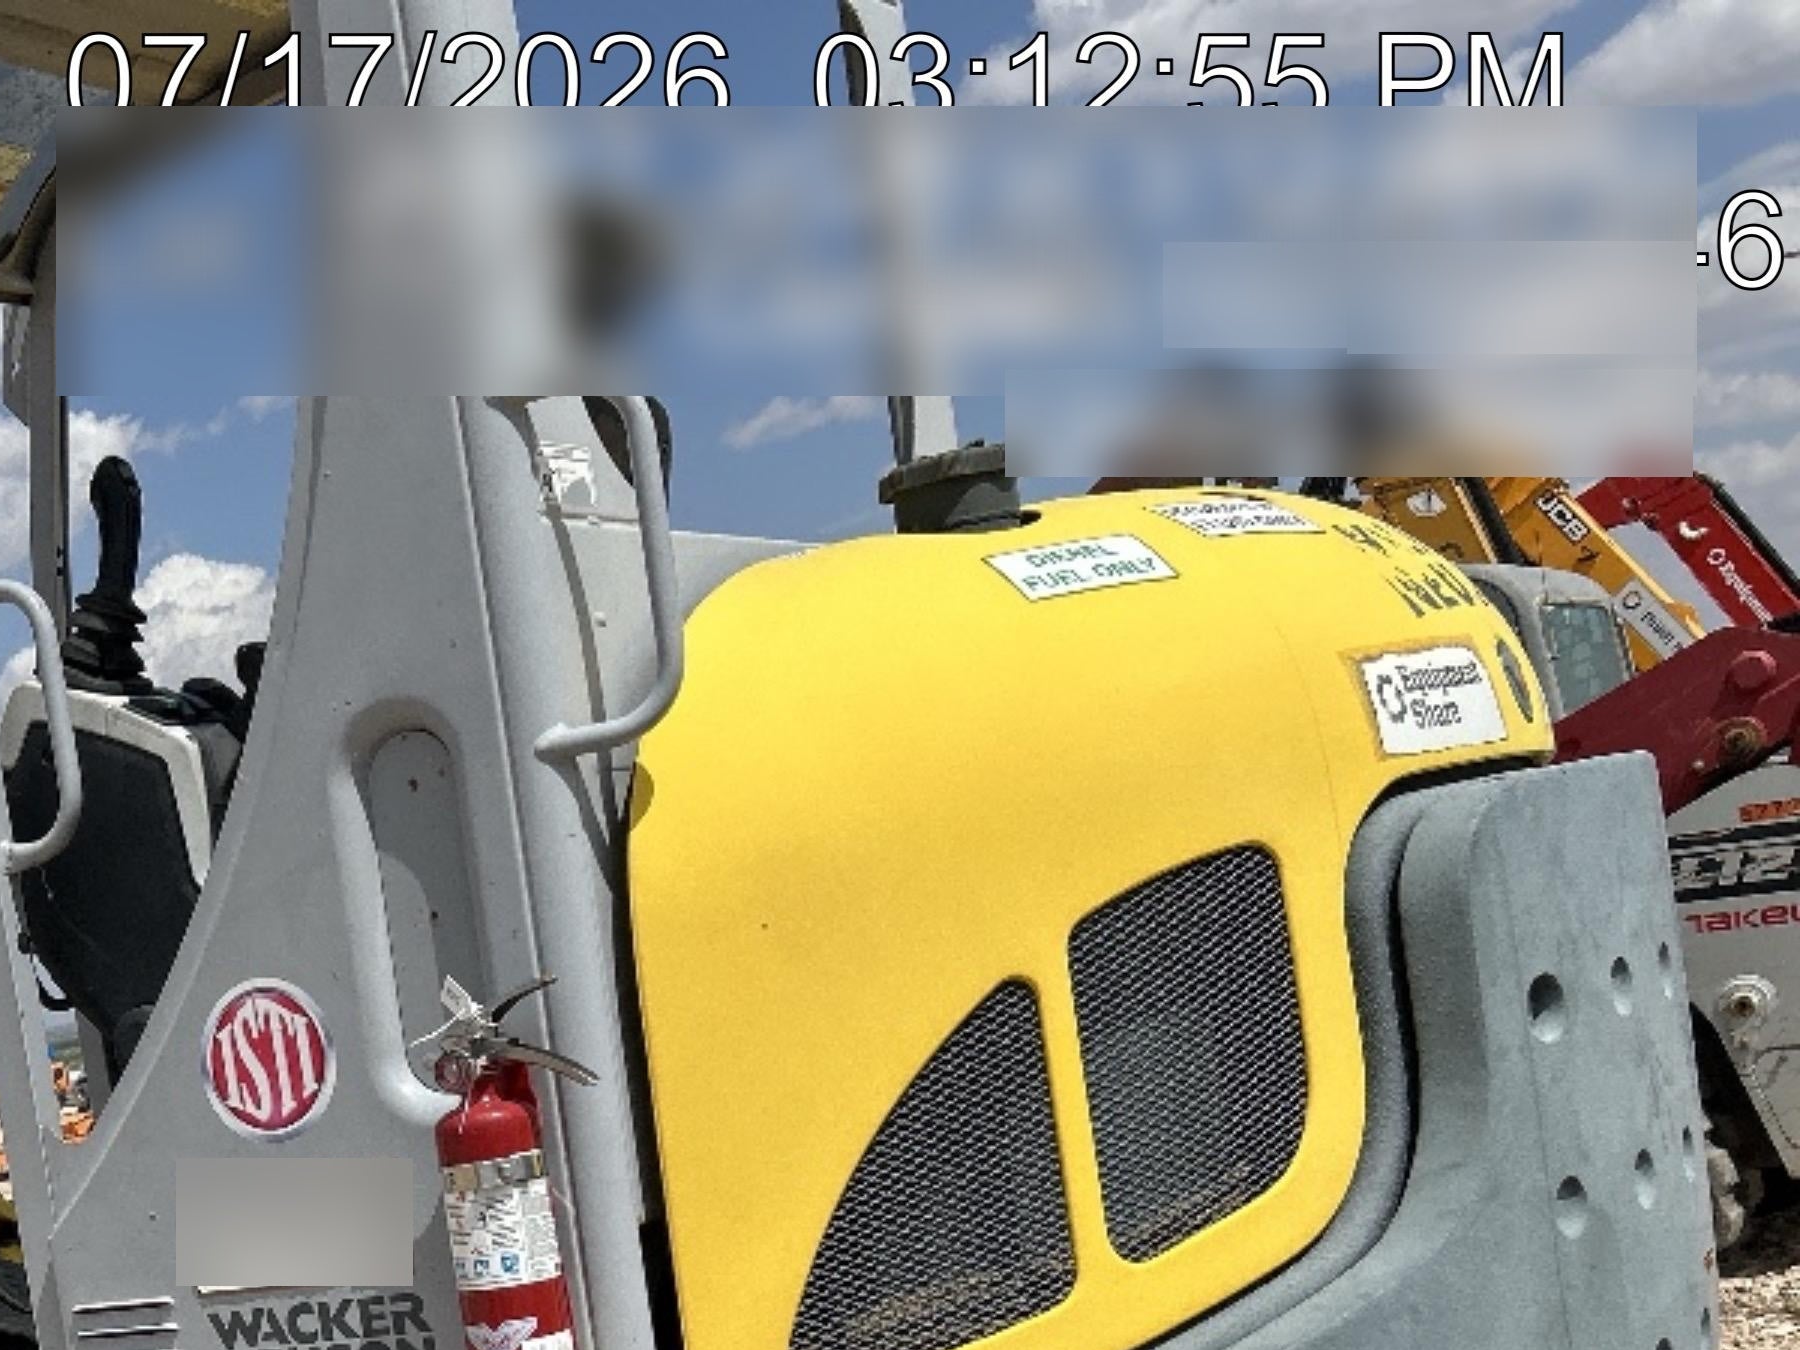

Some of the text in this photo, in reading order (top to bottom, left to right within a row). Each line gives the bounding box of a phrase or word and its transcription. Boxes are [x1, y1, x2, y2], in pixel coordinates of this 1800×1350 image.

[1537, 494, 1590, 542] JCB
[1020, 556, 1157, 591] FUEL ONLY
[206, 1291, 433, 1350] WACKER
